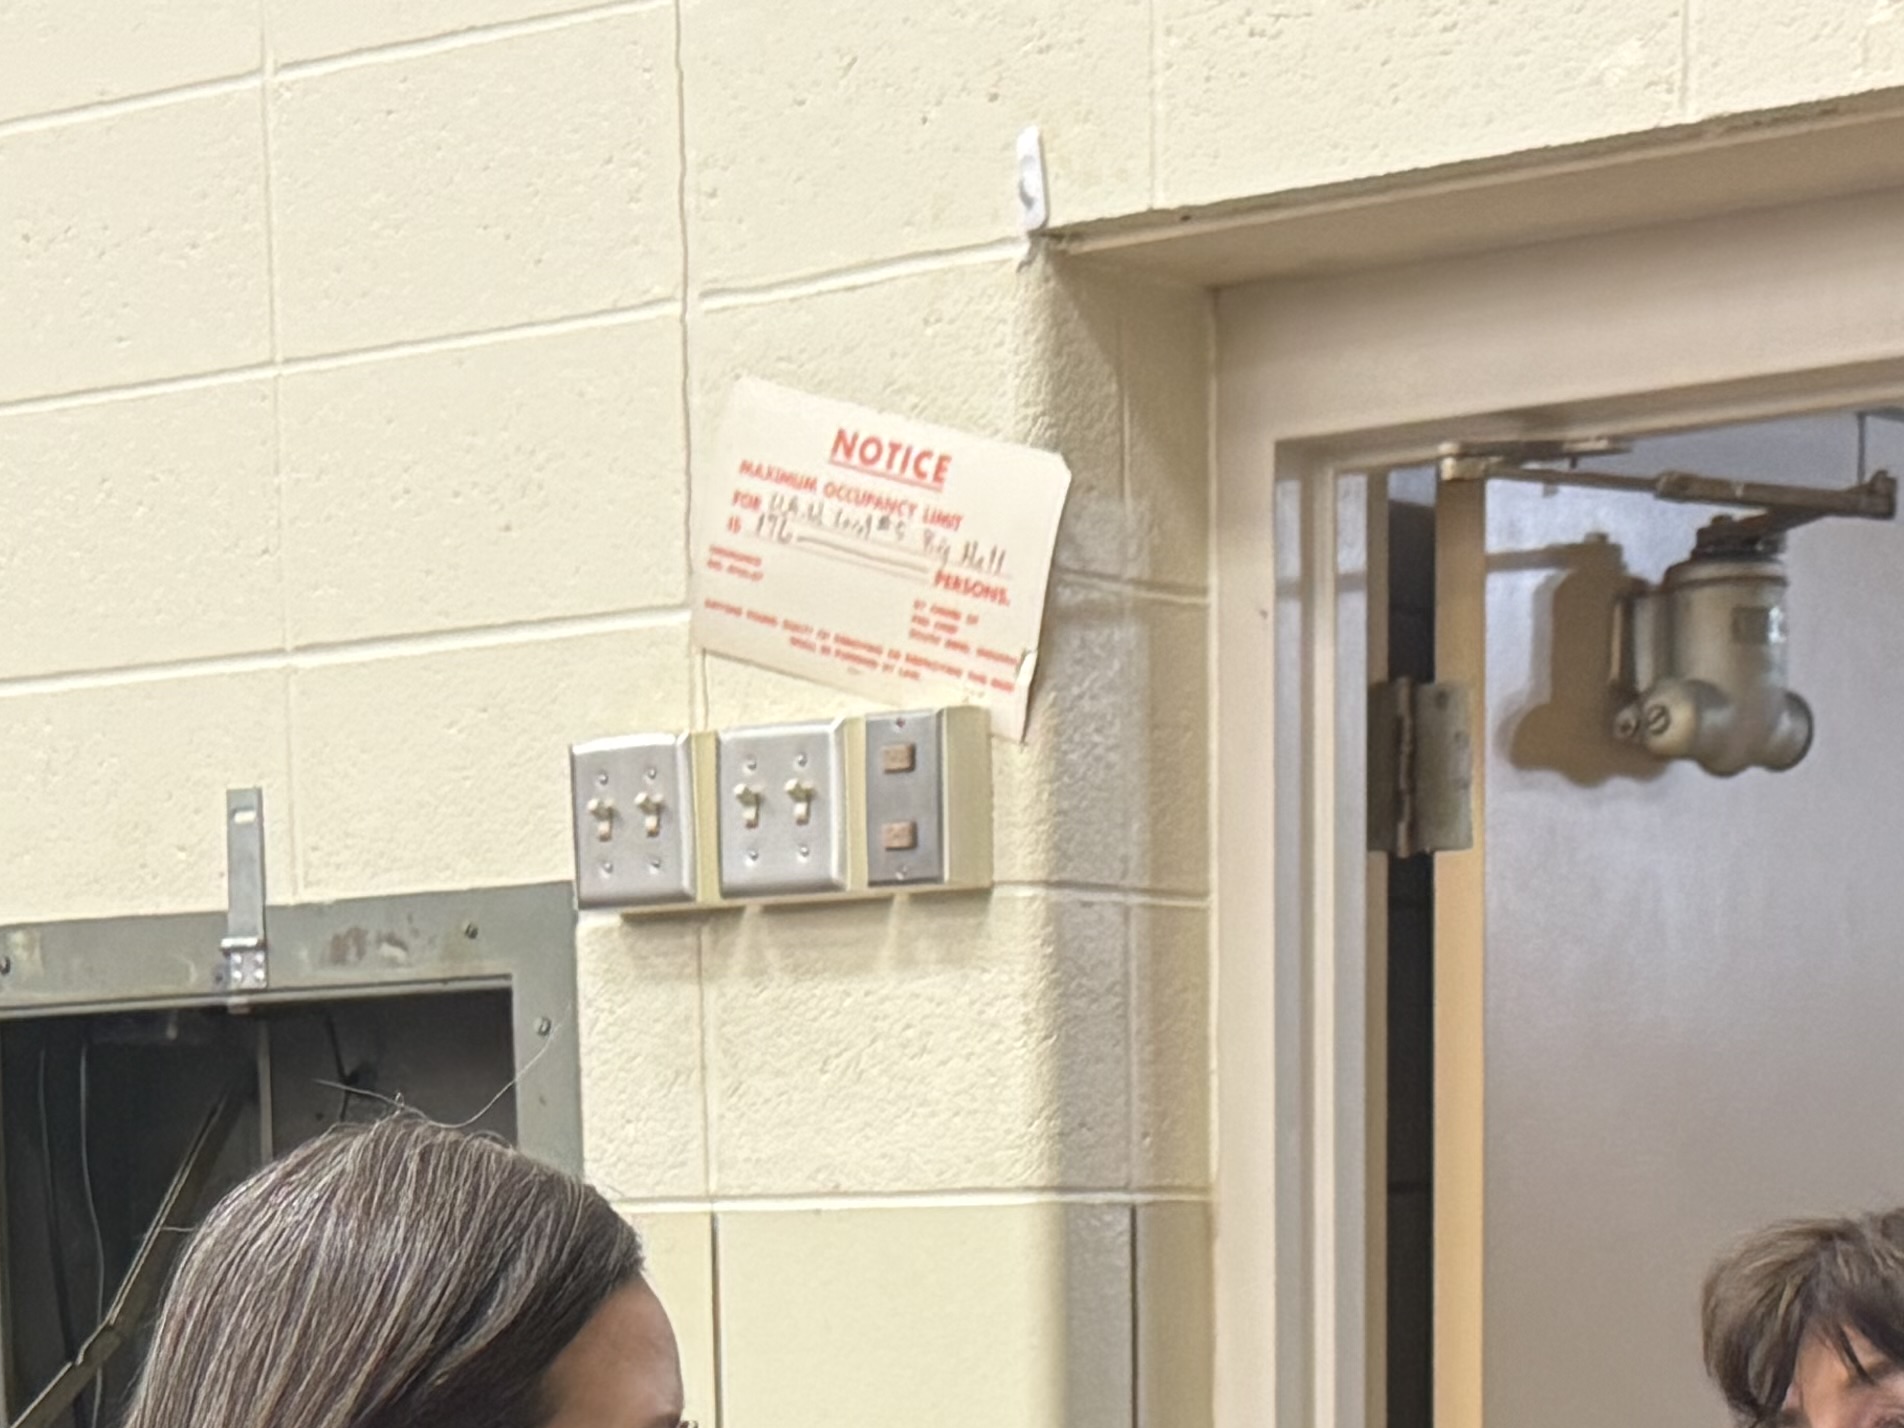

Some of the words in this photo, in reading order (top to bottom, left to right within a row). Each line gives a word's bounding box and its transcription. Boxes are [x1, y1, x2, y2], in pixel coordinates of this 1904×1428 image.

[830, 428, 953, 484] NOTICE
[732, 489, 761, 513] FOR
[739, 459, 817, 493] MAXIMUM
[823, 480, 918, 519] OCCUPANCY
[922, 505, 964, 532] LIMIT
